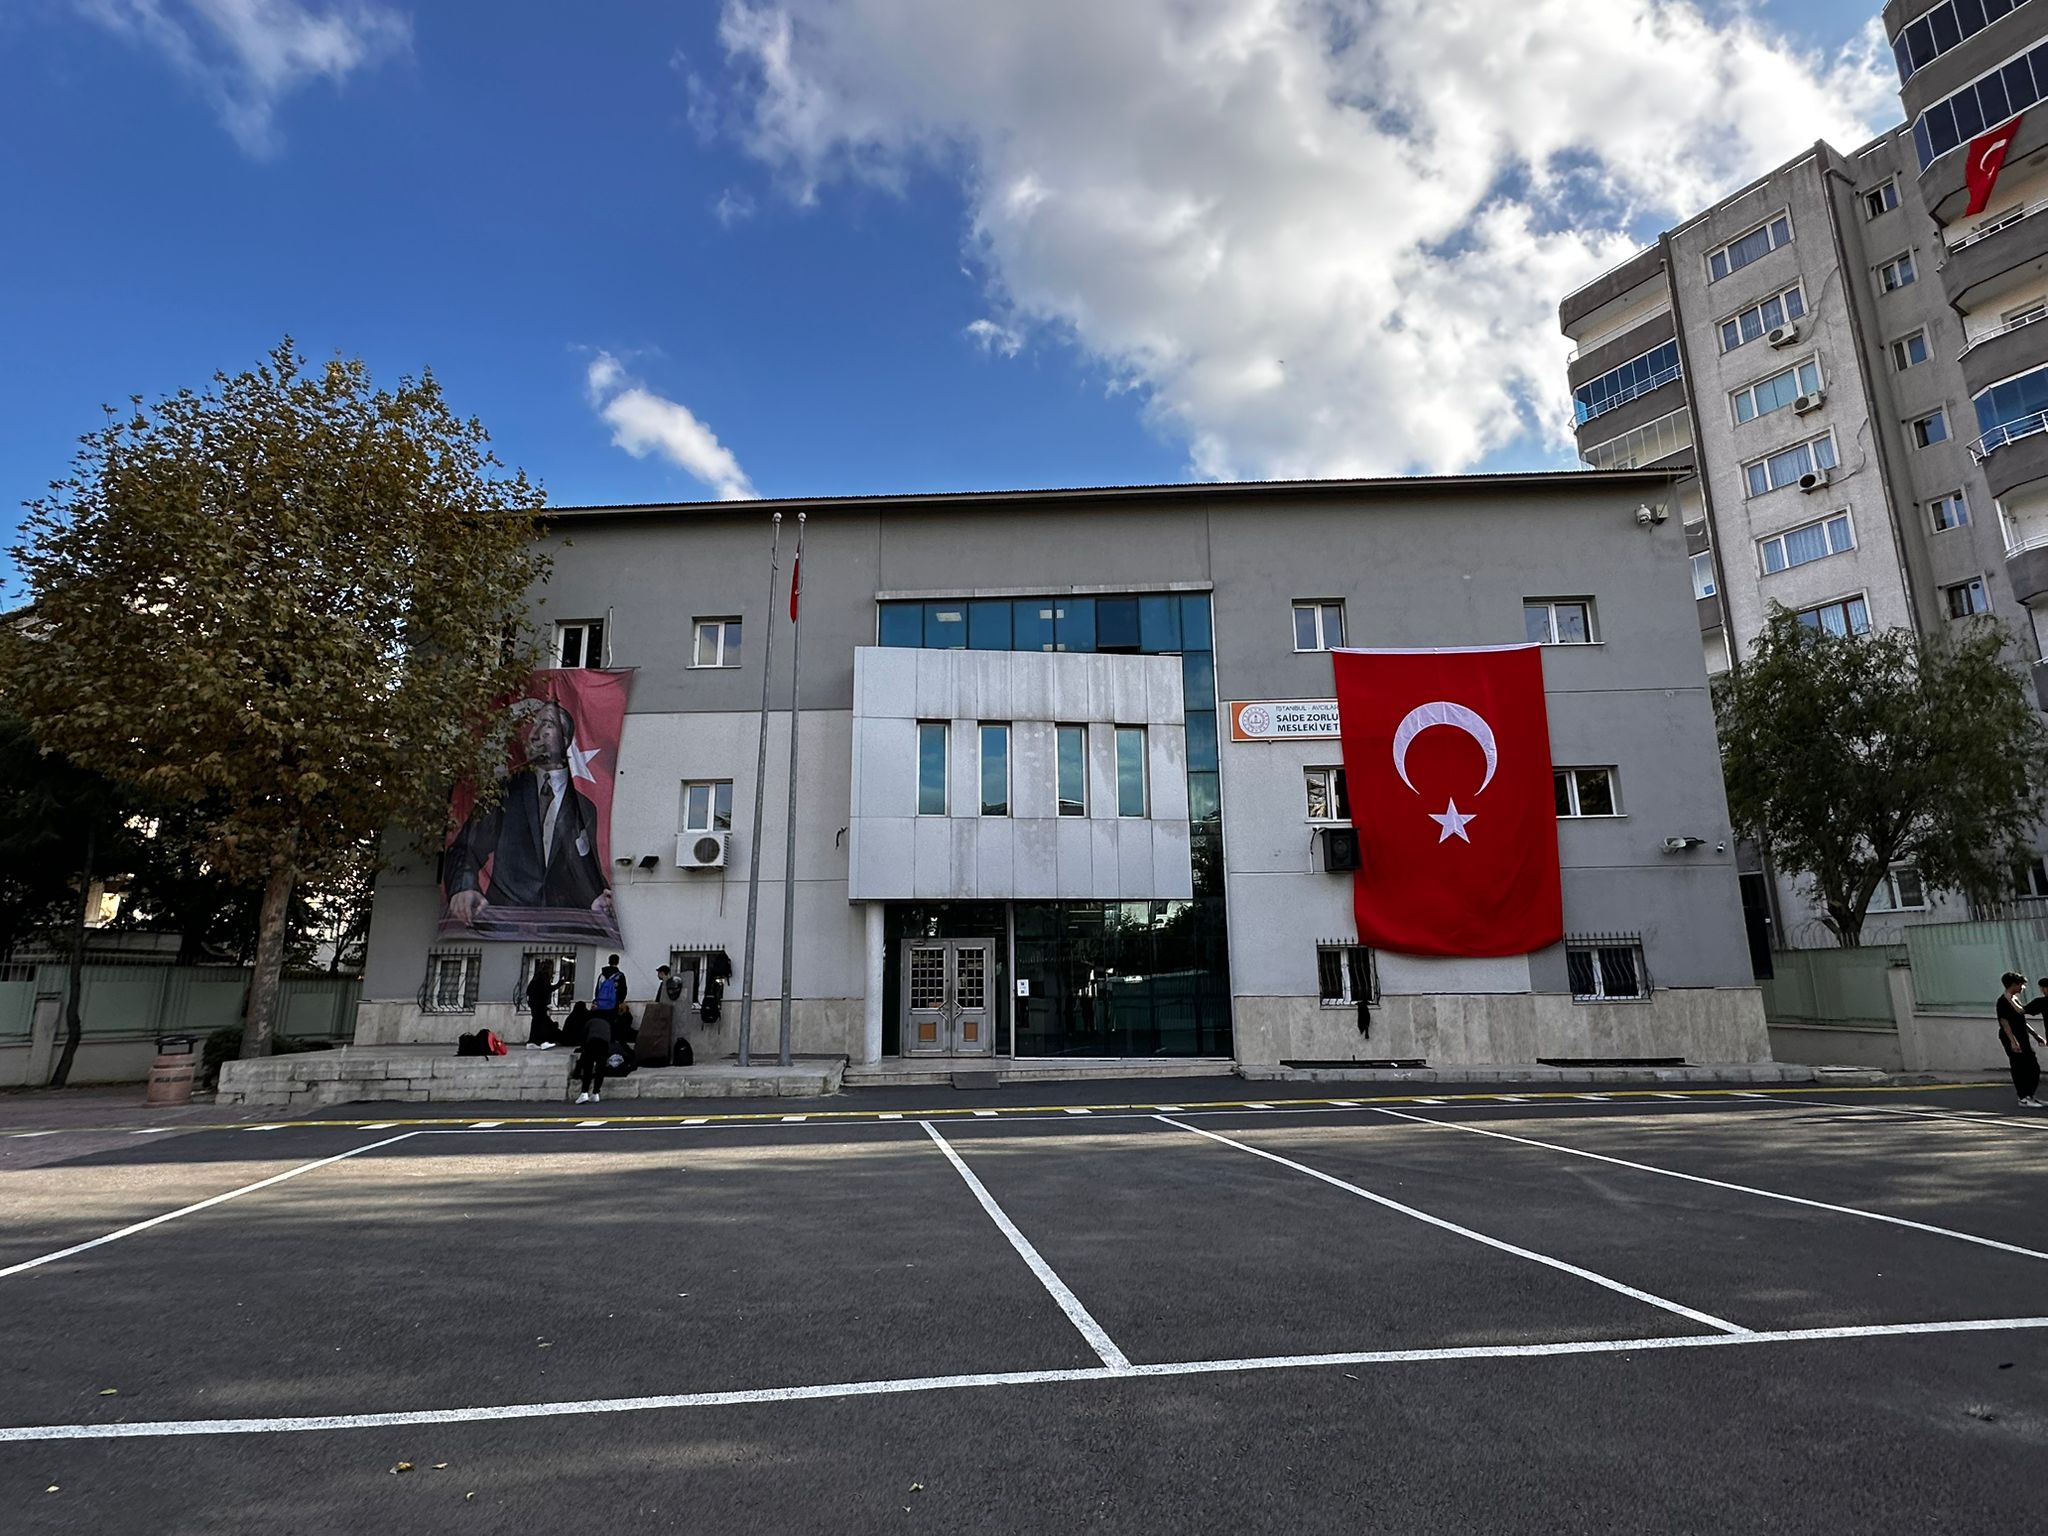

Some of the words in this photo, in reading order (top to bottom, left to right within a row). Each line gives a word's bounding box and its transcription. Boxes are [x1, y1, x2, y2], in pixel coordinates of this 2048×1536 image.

[1276, 714, 1305, 722] SAİDE
[1307, 713, 1338, 721] ZORLU
[1278, 722, 1317, 731] MESLEKİ
[1319, 723, 1331, 731] VE
